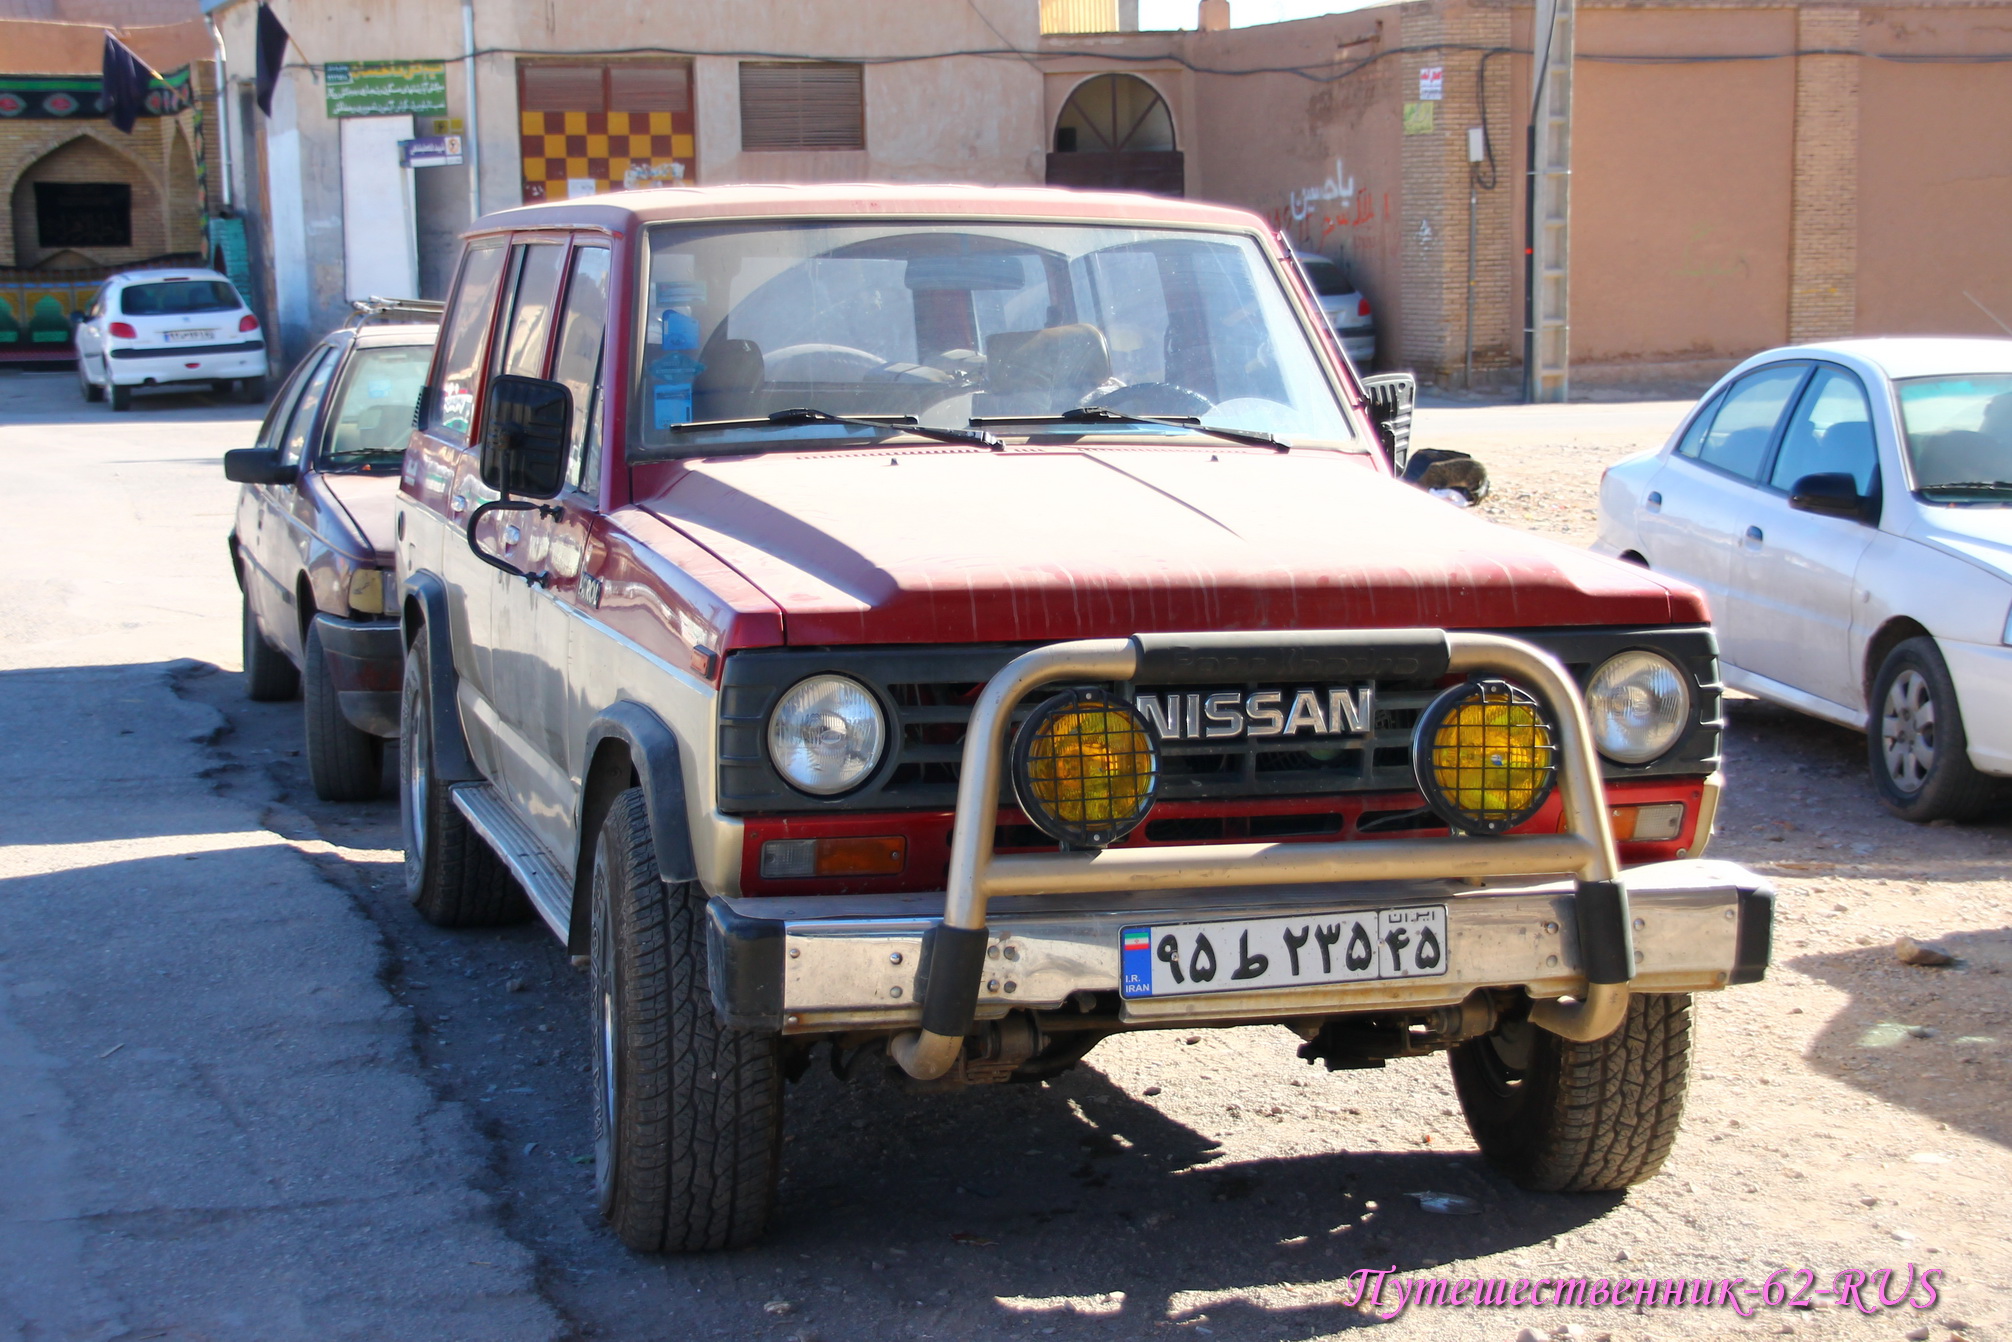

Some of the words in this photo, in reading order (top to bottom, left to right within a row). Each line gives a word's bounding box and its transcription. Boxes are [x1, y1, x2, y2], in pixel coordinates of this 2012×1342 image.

[1137, 688, 1371, 739] NISSAN
[1388, 910, 1435, 924] ایران
[1125, 973, 1141, 983] I.R.
[1125, 983, 1150, 993] IRAN
